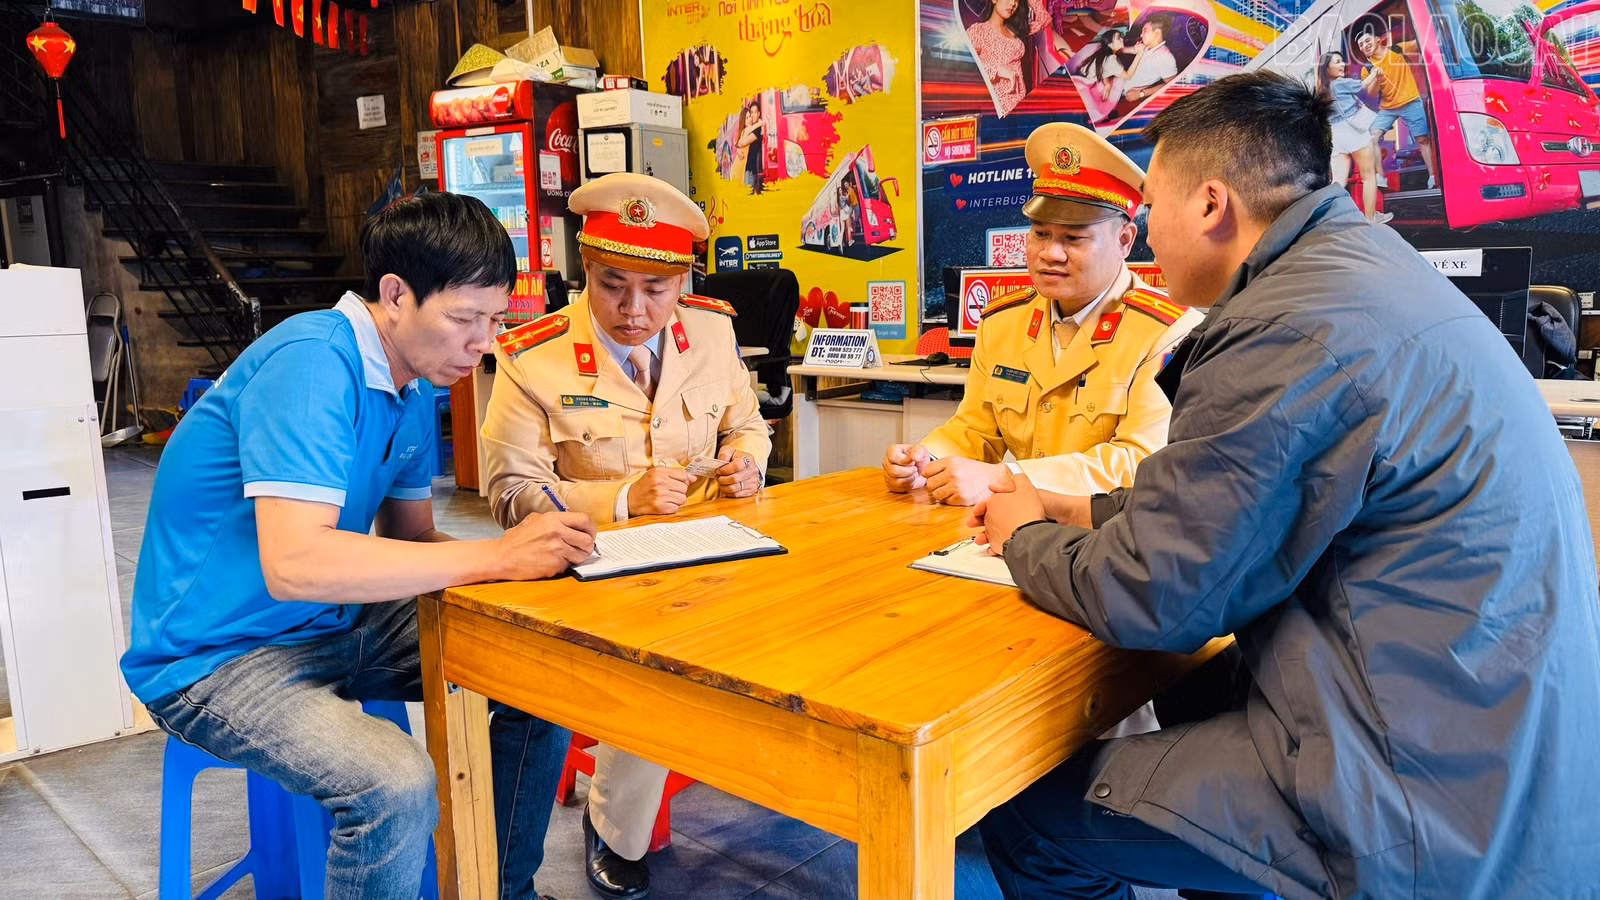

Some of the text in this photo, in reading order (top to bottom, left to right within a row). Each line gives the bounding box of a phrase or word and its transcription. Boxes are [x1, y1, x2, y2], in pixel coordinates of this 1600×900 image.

[968, 168, 1024, 184] HOTLINE
[1433, 259, 1467, 269] VÉ XE
[812, 334, 868, 347] INFORMATION
